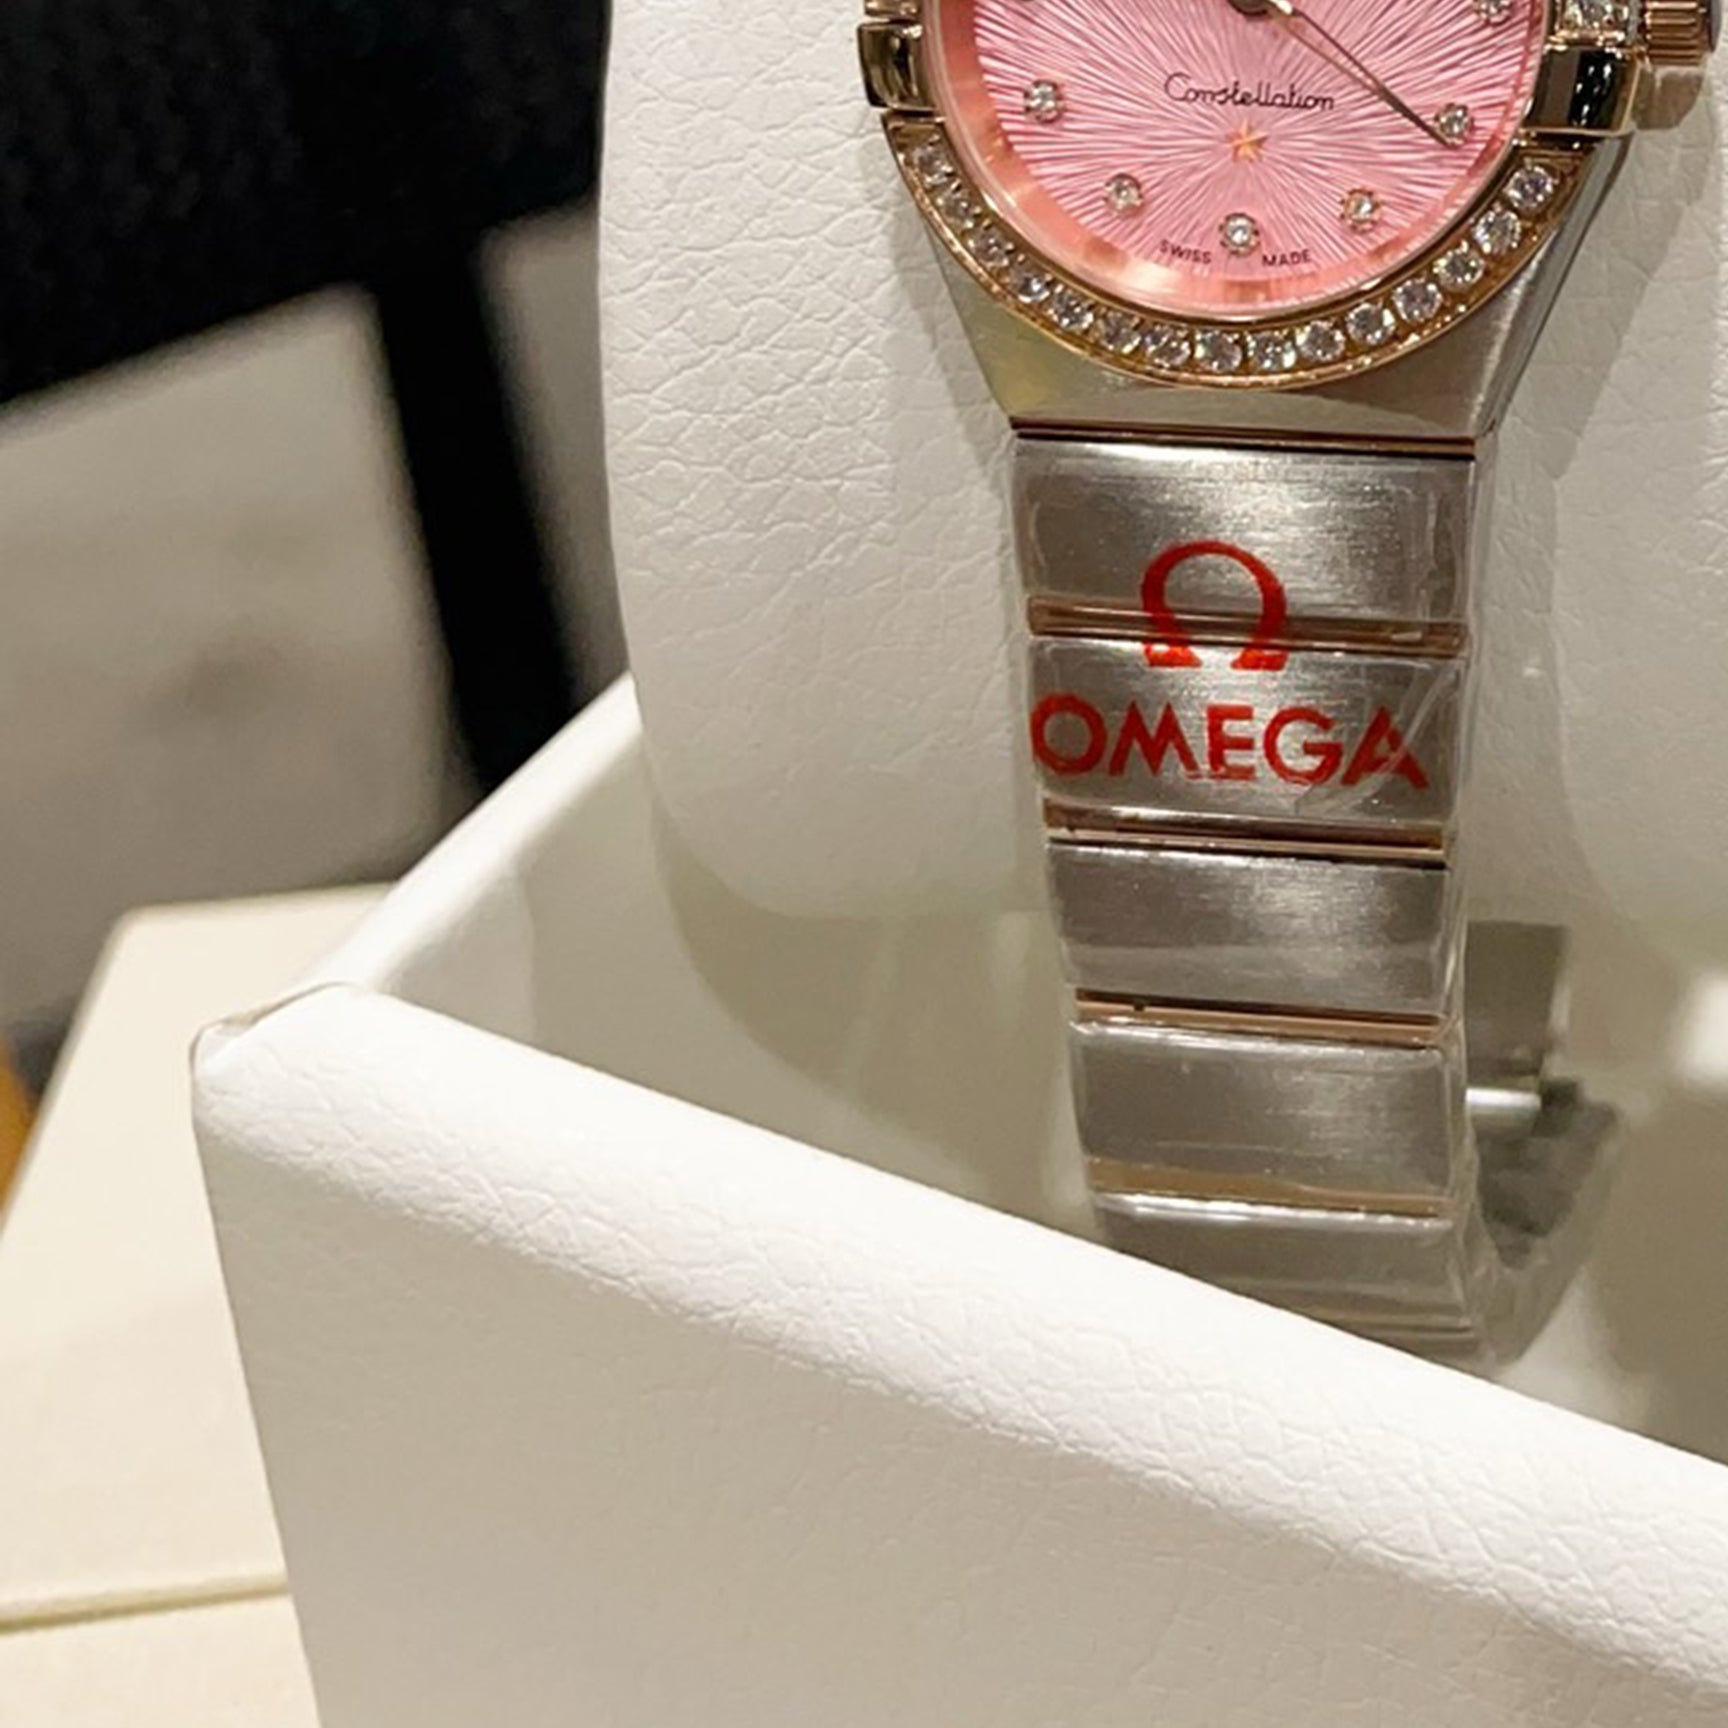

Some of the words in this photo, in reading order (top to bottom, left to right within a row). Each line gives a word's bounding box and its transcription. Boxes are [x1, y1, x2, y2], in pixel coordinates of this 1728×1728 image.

[1164, 71, 1335, 111] Constellation
[1159, 239, 1212, 265] SWISS
[1261, 249, 1313, 267] MADE
[1031, 693, 1430, 790] OMEGA
